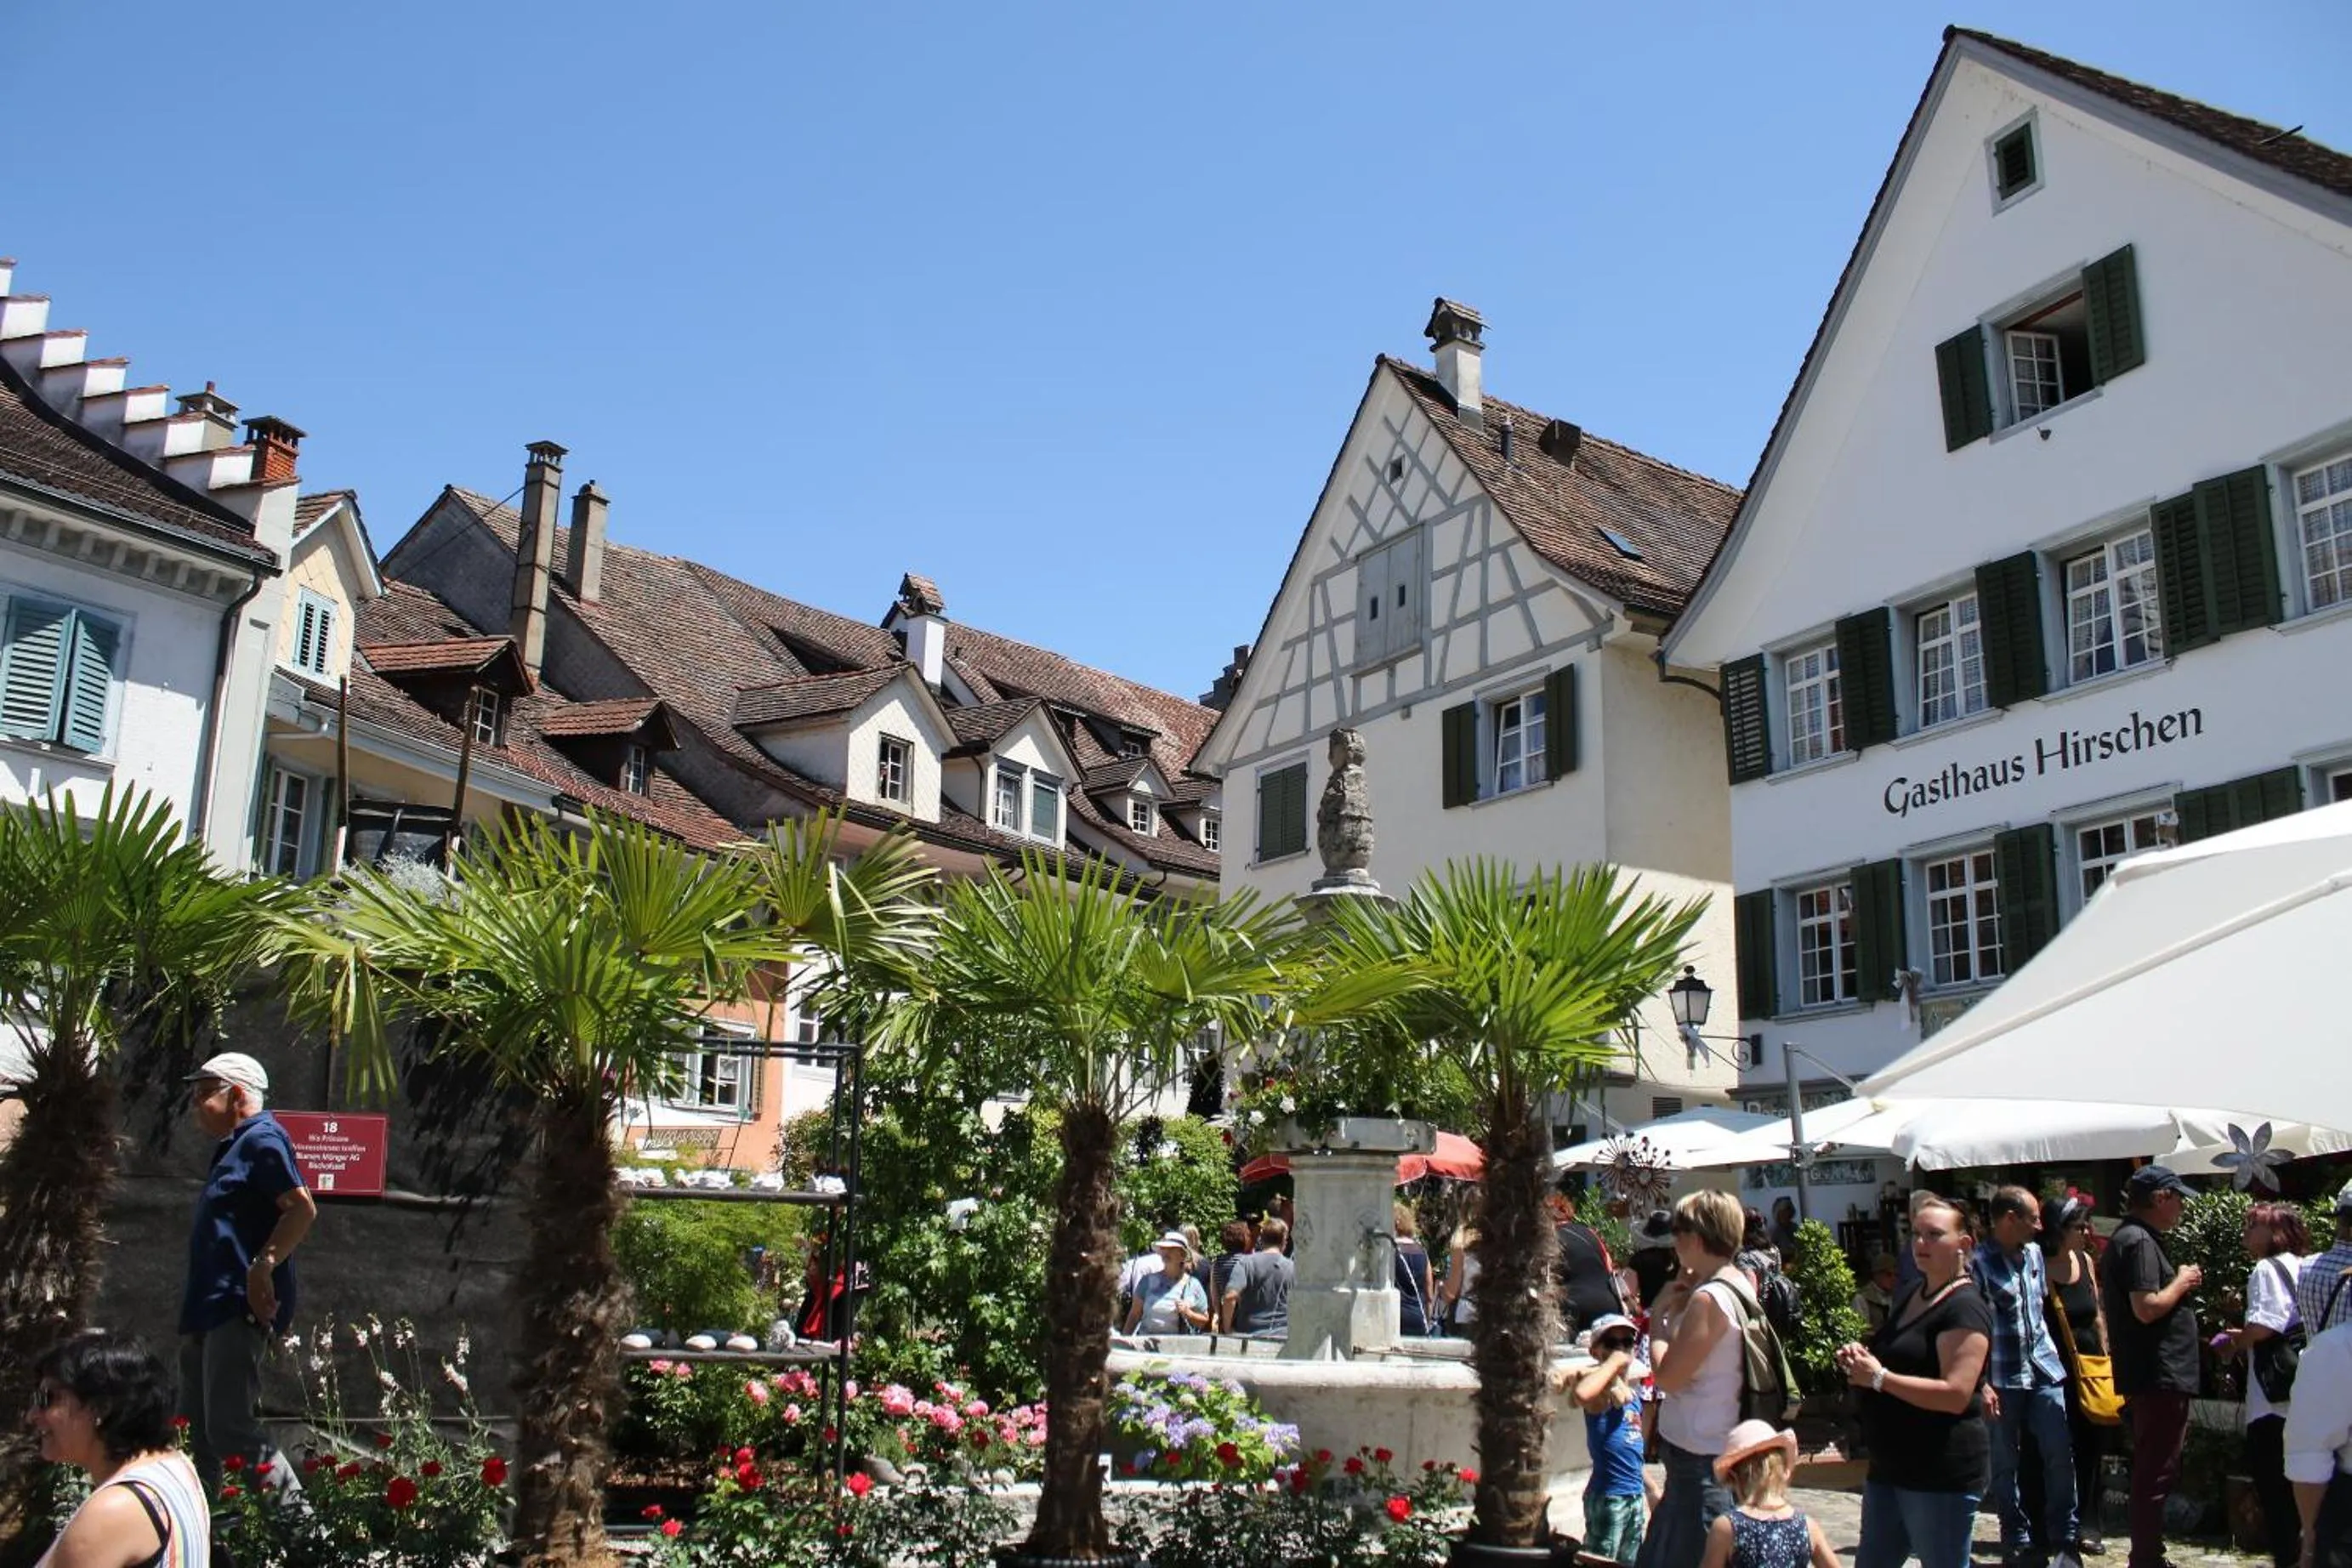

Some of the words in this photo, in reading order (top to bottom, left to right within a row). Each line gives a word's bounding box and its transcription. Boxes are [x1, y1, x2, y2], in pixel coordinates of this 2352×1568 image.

[1883, 755, 2025, 817] Gasthaus
[2034, 707, 2203, 776] Hirschen
[322, 1122, 338, 1133] 18
[349, 1153, 361, 1162] AG
